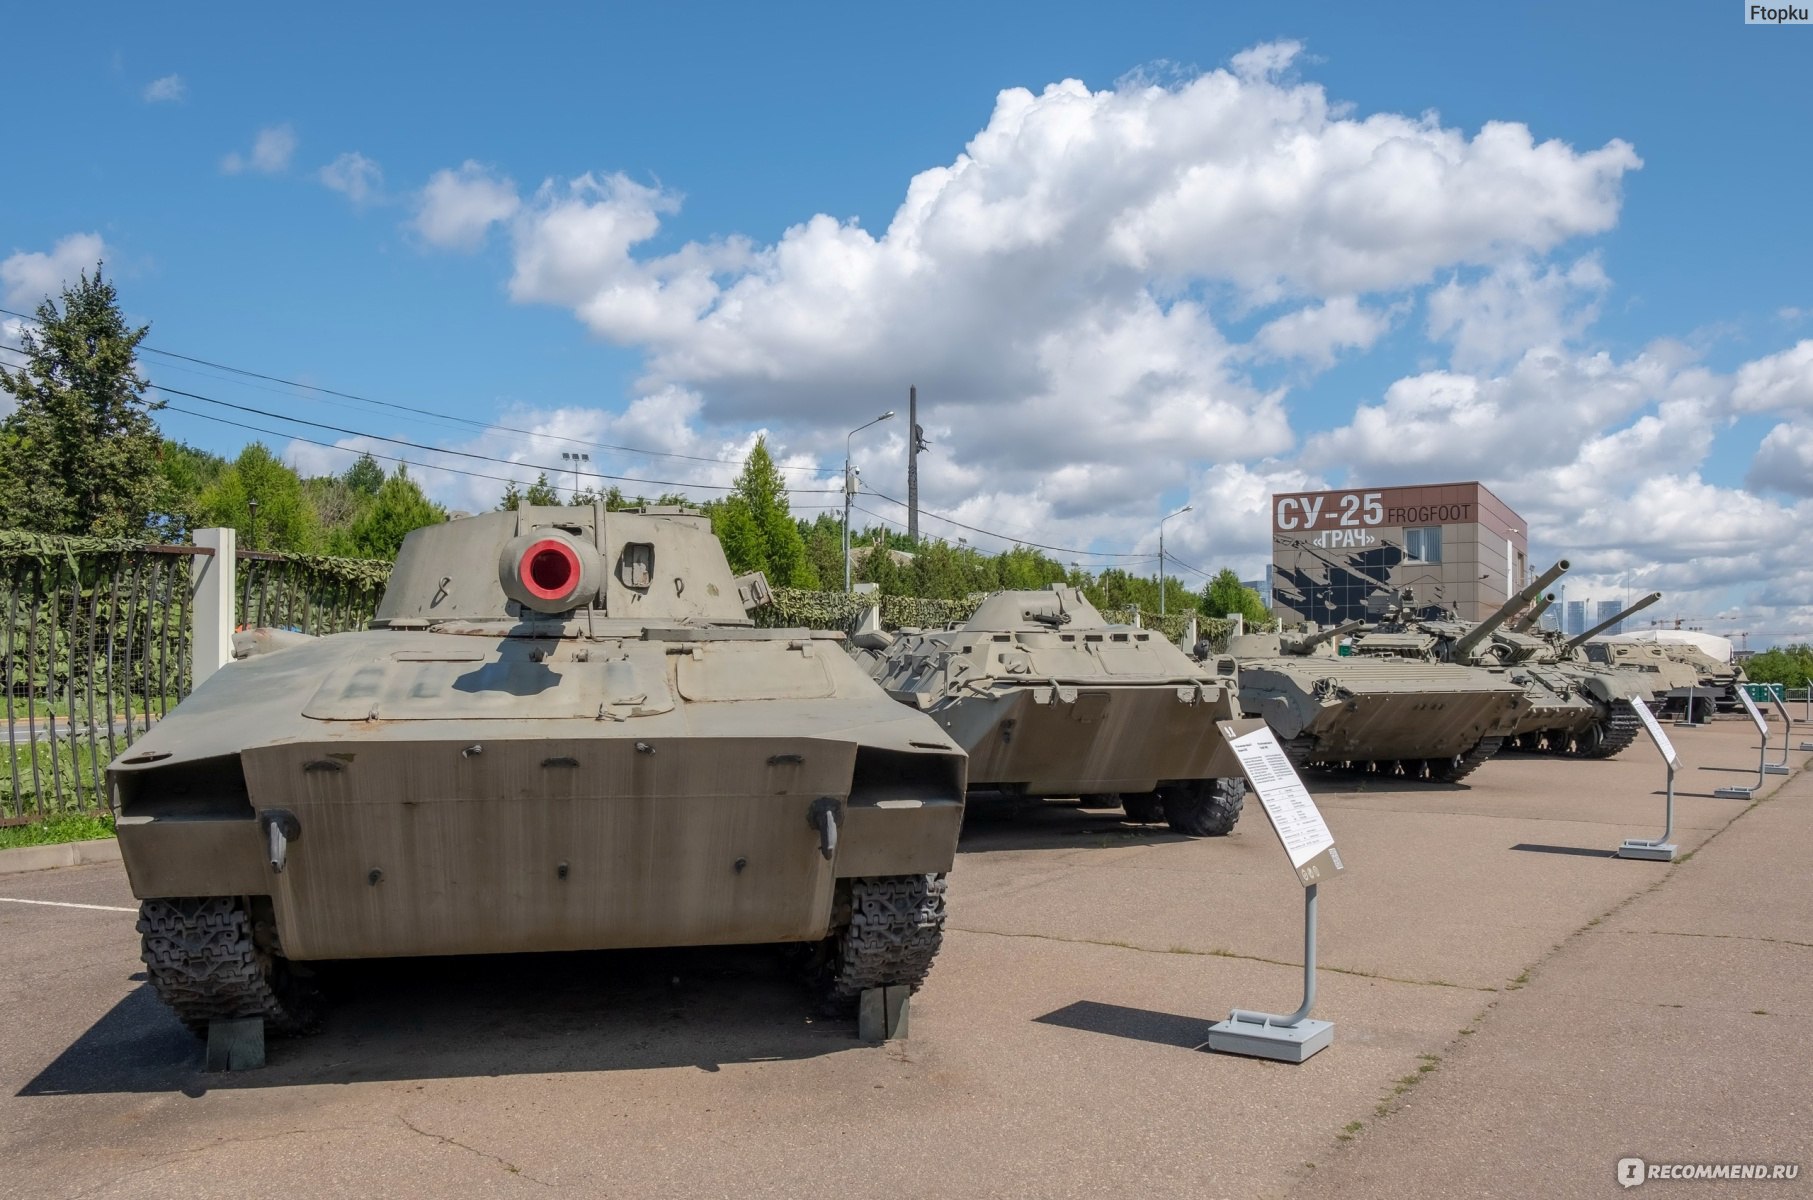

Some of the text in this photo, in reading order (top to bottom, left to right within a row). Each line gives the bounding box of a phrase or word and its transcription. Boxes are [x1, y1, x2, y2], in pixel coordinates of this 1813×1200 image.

[1277, 493, 1384, 530] СУ-25
[1388, 505, 1471, 523] FROGFOOT
[1313, 529, 1375, 548] «ГРАЧ»
